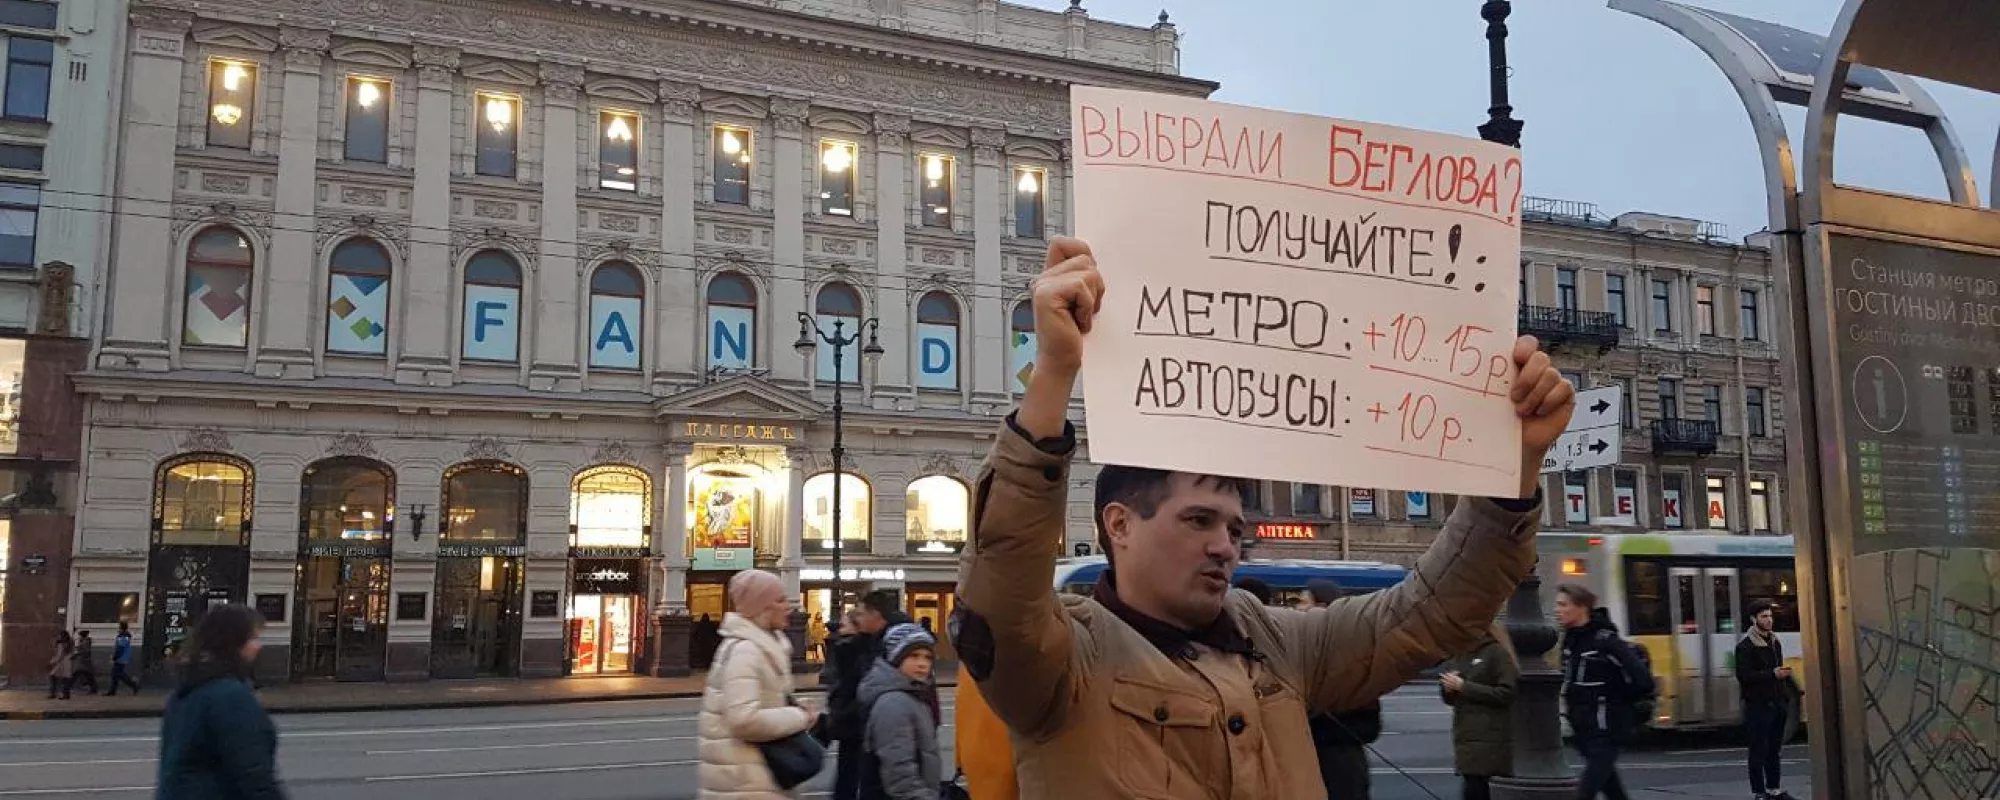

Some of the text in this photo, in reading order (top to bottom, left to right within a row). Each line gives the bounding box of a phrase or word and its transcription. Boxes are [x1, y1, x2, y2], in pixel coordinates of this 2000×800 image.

[1081, 105, 1523, 224] ВЫБРАЛИ БЕГЛОВА?
[1851, 257, 1999, 299] Станция метро
[1136, 284, 1352, 352] МЕТРО:
[1835, 287, 1957, 324] ГОСТИНЫЙ
[1135, 356, 1352, 430] АВТОБУСЫ:
[685, 422, 796, 440] ПАССАЖЪ
[1567, 442, 1582, 457] 1.3
[1256, 525, 1315, 539] АПТЕКА
